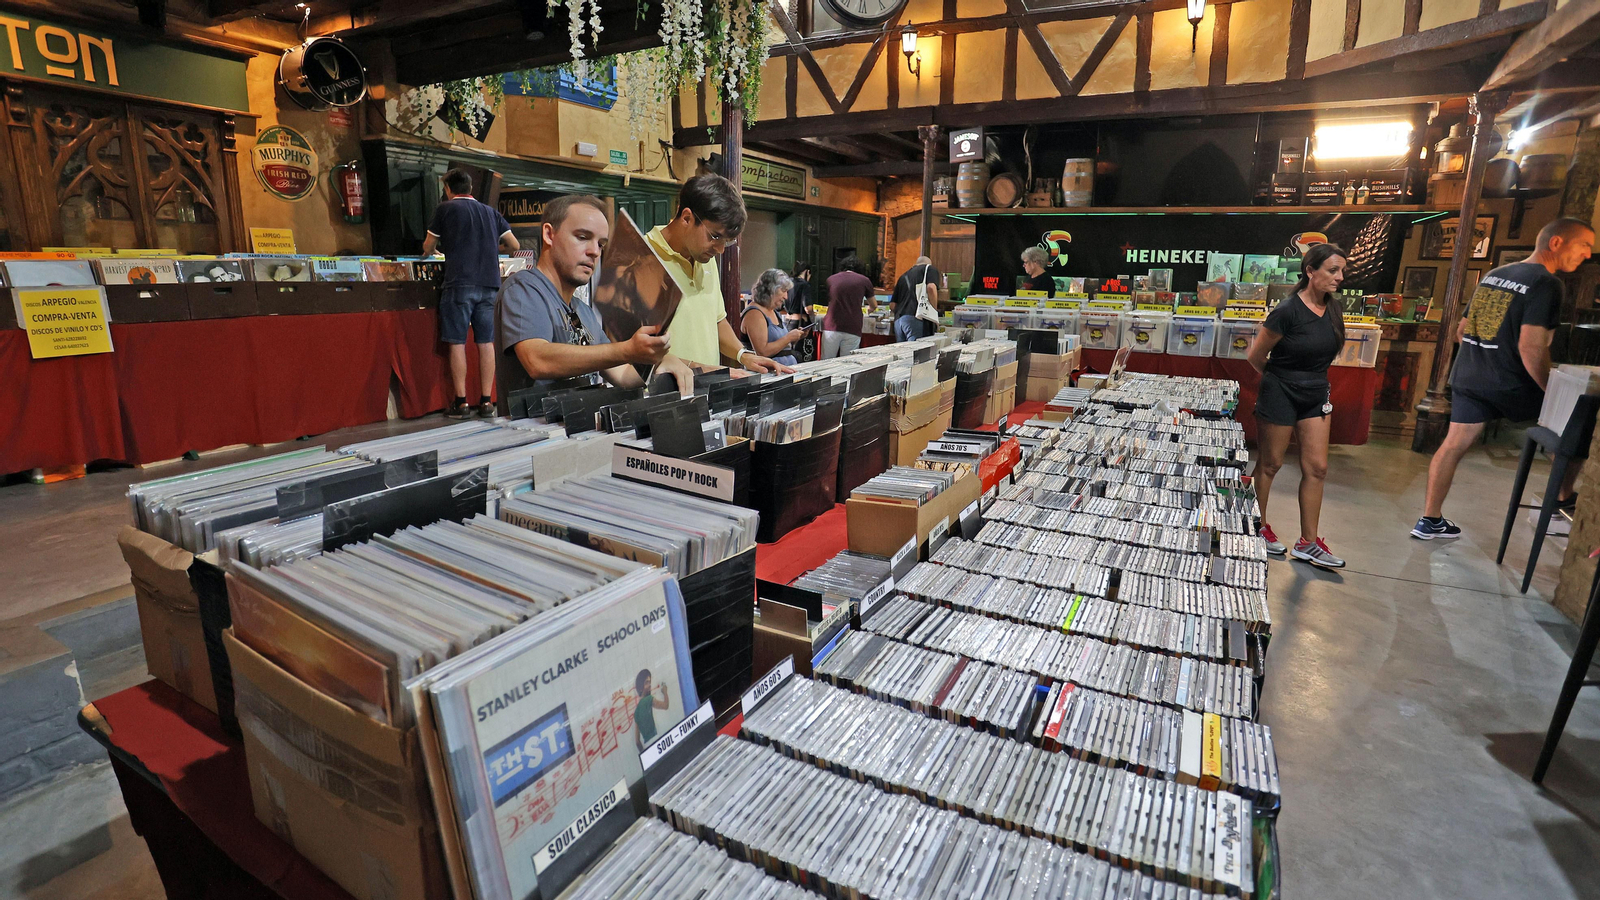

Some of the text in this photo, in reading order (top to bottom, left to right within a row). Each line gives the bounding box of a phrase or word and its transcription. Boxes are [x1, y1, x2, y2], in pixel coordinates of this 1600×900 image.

[320, 77, 361, 96] GUINNESS
[267, 168, 308, 180] IRISH RED
[1432, 226, 1486, 238] GUINSS
[104, 265, 128, 275] HARVEST
[152, 264, 172, 274] WORLD
[1502, 279, 1530, 295] ROCK
[41, 297, 77, 306] ARPEGIO
[32, 311, 97, 323] COMPRA-VENTA
[31, 327, 54, 336] DISCOS
[63, 325, 84, 333] VINILO
[940, 441, 968, 452] AÑOS 70'S
[626, 456, 718, 489] ESPAÑOLES POP Y ROCK
[505, 512, 564, 540] mecano
[867, 584, 886, 605] COUNTRY
[476, 604, 667, 722] STANLEY CLARKE SCHOOL DAYS
[752, 669, 782, 702] AÑOS 60'S
[656, 734, 674, 755] SOUL
[679, 714, 700, 740] FUNKY
[547, 829, 577, 860] SOUL
[577, 789, 617, 833] CLASICO
[1223, 852, 1234, 875] THE
